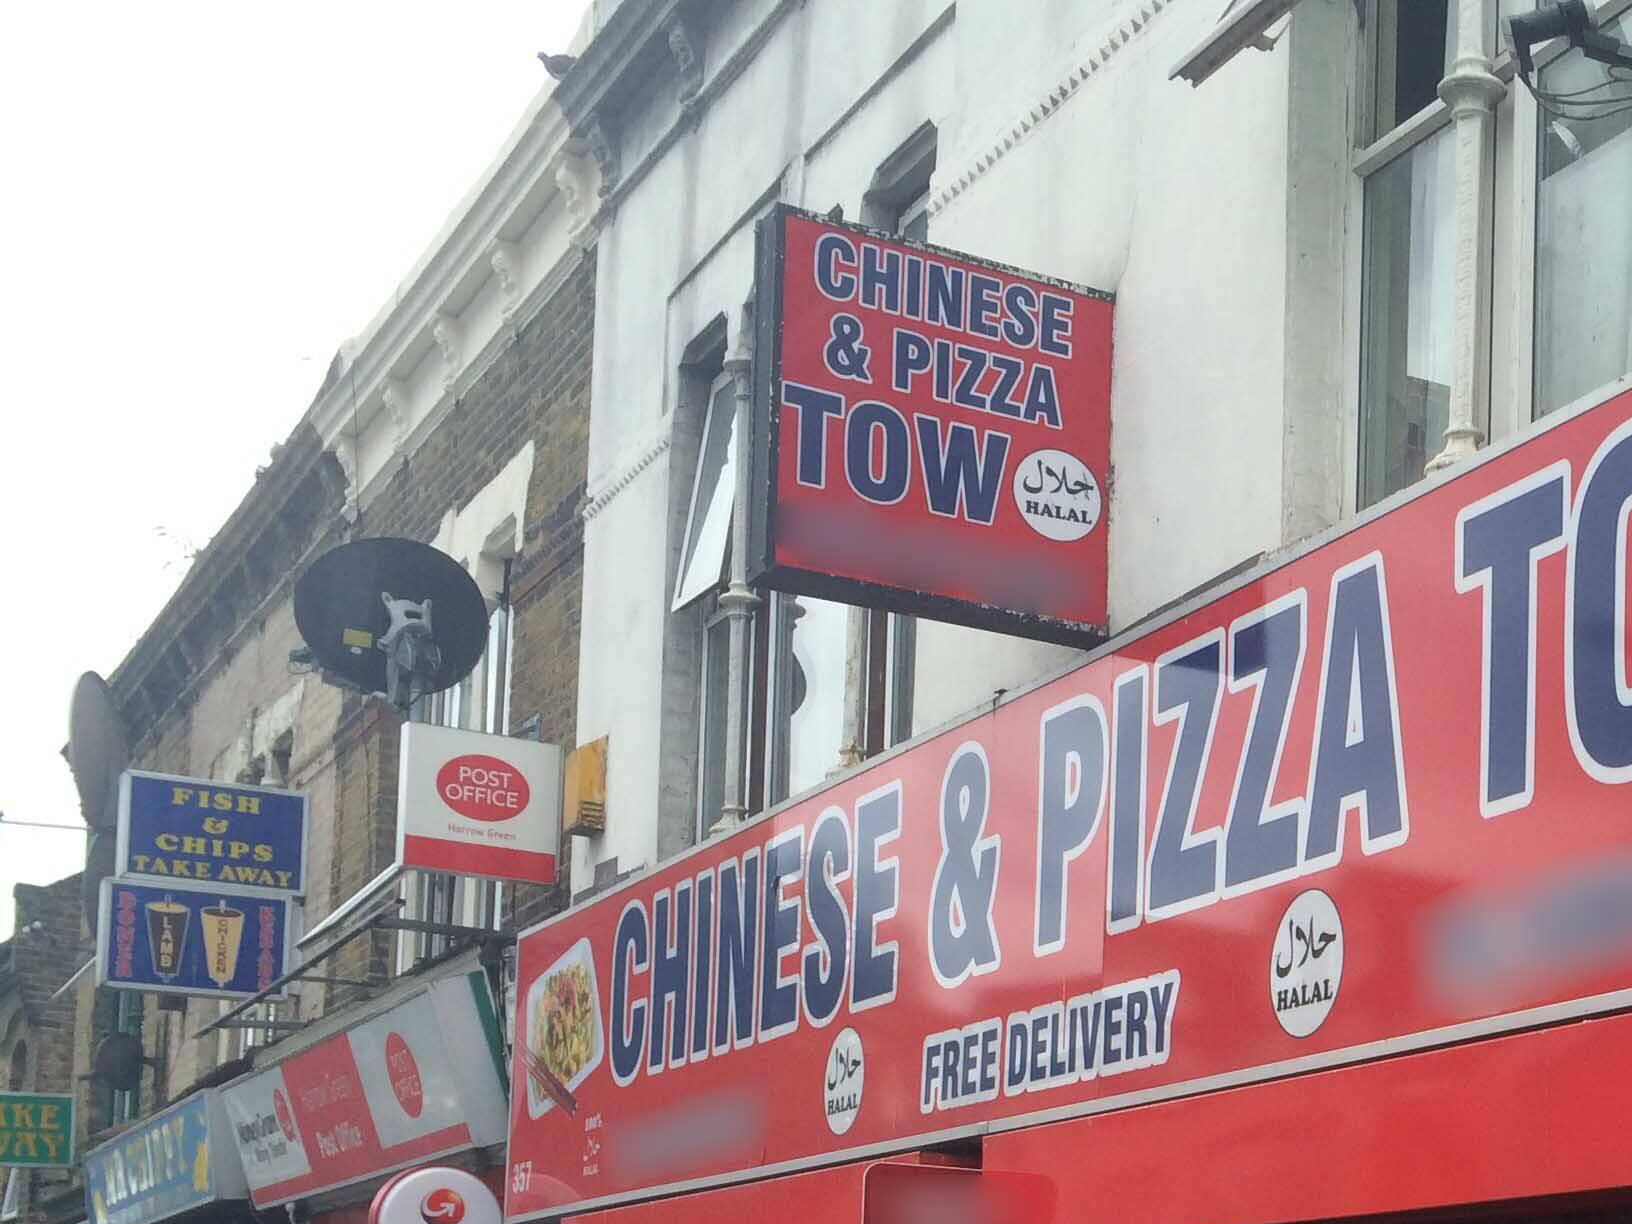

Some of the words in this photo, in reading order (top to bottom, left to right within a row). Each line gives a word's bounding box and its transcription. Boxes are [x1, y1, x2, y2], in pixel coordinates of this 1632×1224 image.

[815, 233, 1073, 358] CHINESE
[823, 313, 872, 383] &
[893, 328, 1063, 429] PIZZA
[782, 382, 1011, 525] TOW
[1023, 459, 1094, 499] حلال
[1025, 501, 1093, 525] HALAL
[459, 766, 513, 788] POST
[172, 787, 261, 815] FISH
[445, 783, 519, 808] OFFICE
[202, 817, 229, 834] &
[610, 778, 902, 1087] CHINESE
[928, 740, 1001, 989] &
[1034, 550, 1409, 957] PIZZA
[154, 833, 273, 862] CHIPS
[133, 855, 211, 879] TAKE
[219, 864, 293, 887] AWAY
[160, 916, 173, 968] LAMB
[1276, 921, 1336, 978] حلال
[1276, 978, 1333, 1011] HALAL
[921, 1018, 1001, 1113] FREE
[1004, 970, 1180, 1102] DELIVERY
[0, 1103, 59, 1129] KE
[828, 1093, 858, 1116] HALAL
[512, 1161, 532, 1194] 357
